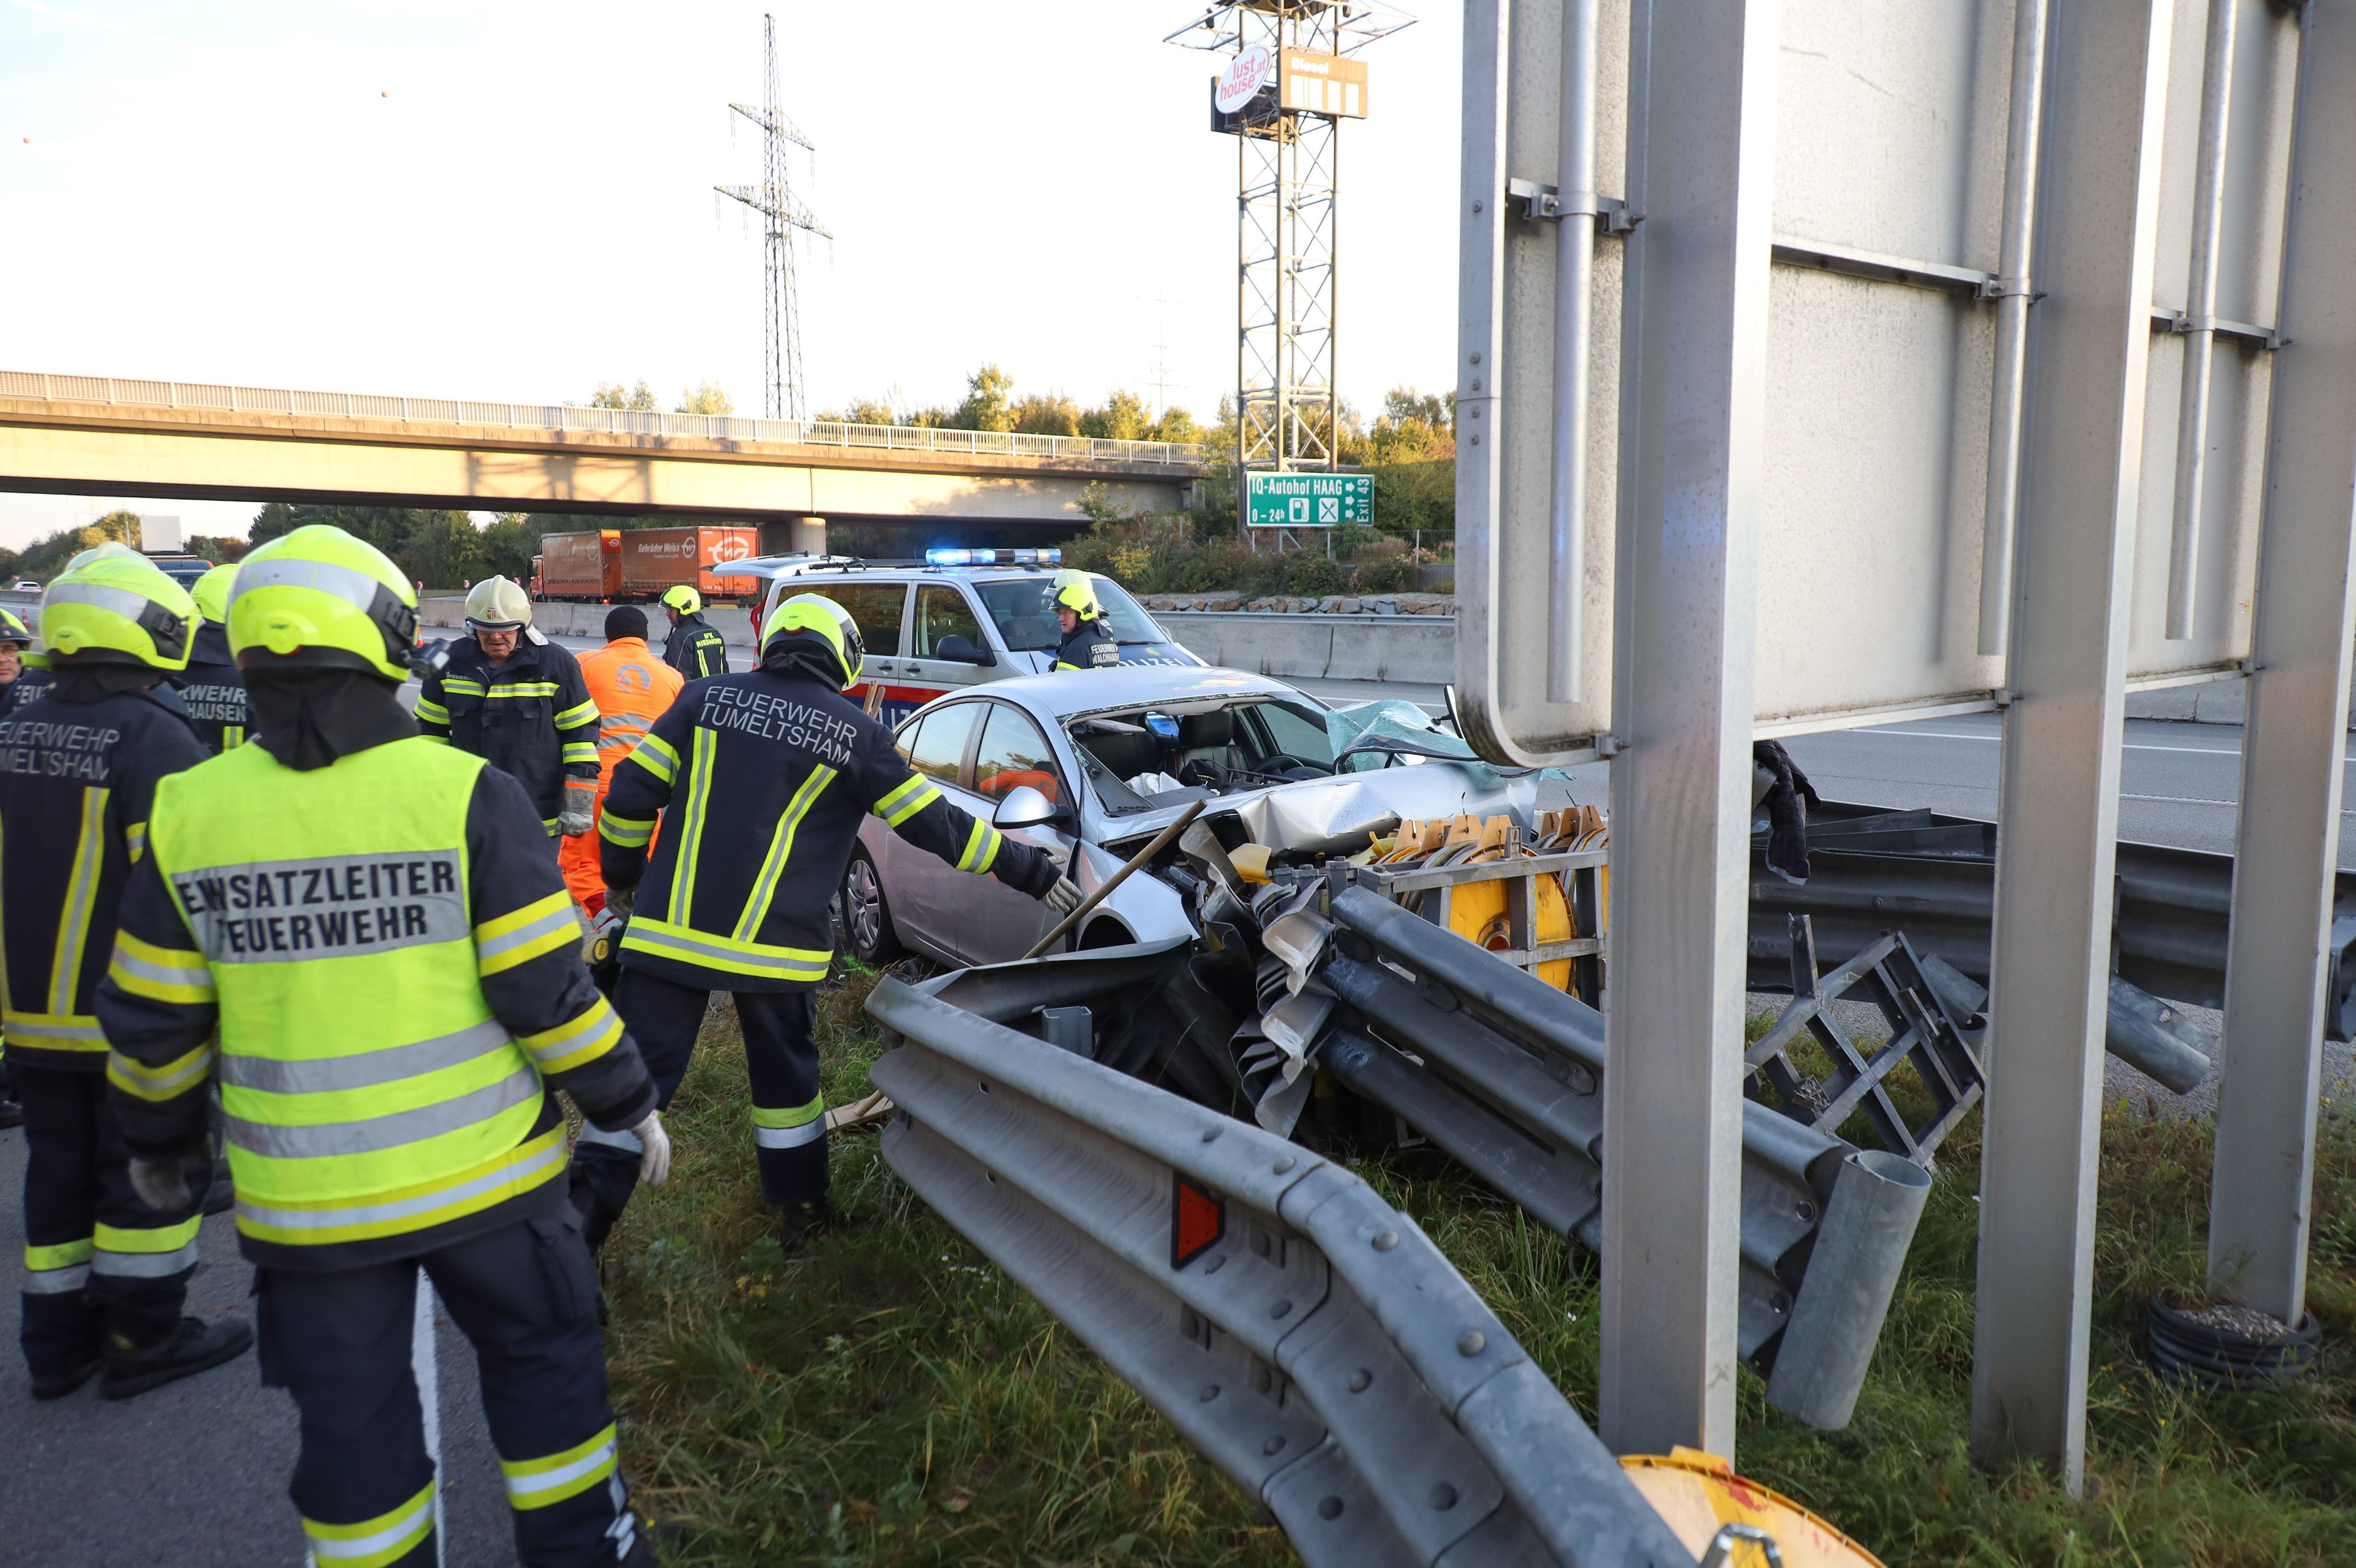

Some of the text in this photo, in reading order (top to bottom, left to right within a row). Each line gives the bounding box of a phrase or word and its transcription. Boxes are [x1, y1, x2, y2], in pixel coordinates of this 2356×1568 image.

[1233, 54, 1256, 81] lust
[1220, 76, 1255, 102] house
[1252, 477, 1342, 495] IQ-Autohof HAAG
[1357, 478, 1369, 494] 43
[638, 542, 663, 553] Gebrüder
[663, 542, 680, 552] Weiss
[704, 686, 857, 748] FEUERWEHR
[699, 703, 851, 766] TUMELTSHAM
